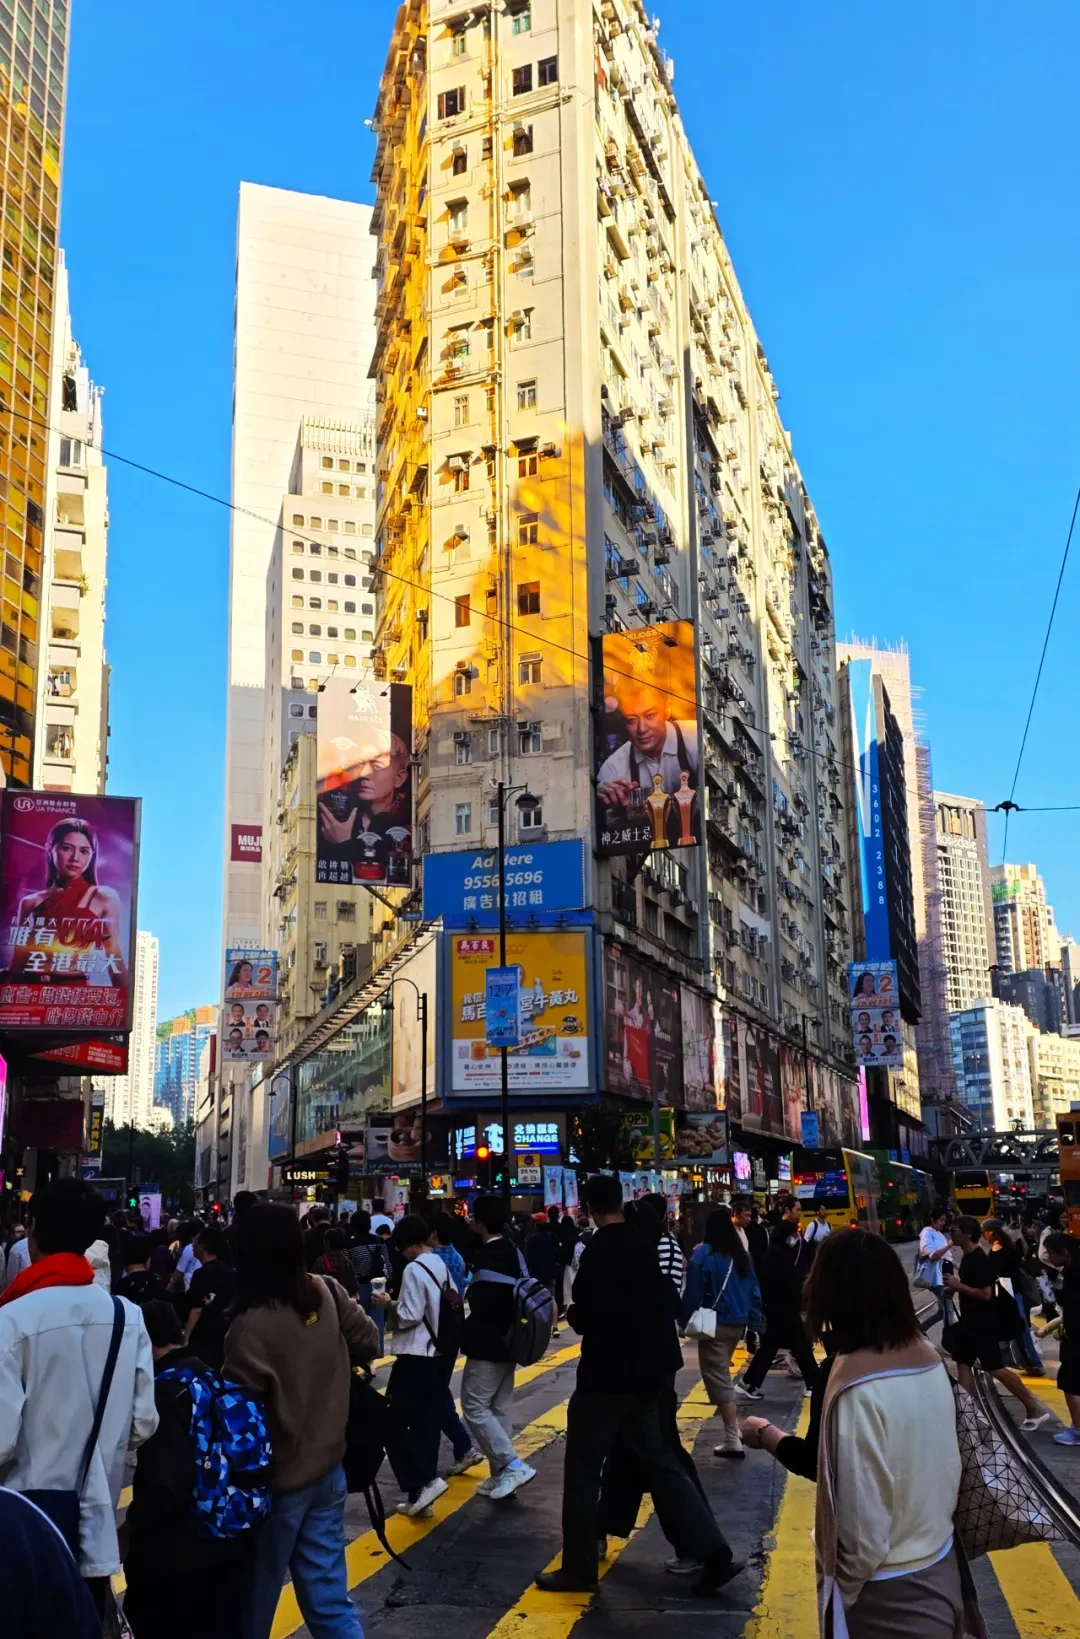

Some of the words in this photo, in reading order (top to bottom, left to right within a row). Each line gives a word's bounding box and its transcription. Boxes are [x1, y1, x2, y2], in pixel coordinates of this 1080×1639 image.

[600, 826, 653, 846] 神之威士忌
[471, 855, 496, 869] Ad
[463, 873, 500, 890] 9556
[505, 870, 543, 886] 5696
[25, 950, 122, 974] 全港最大
[257, 966, 272, 984] 2
[879, 975, 894, 993] 2
[514, 1134, 558, 1143] CHANGE
[286, 1171, 316, 1180] LUSH
